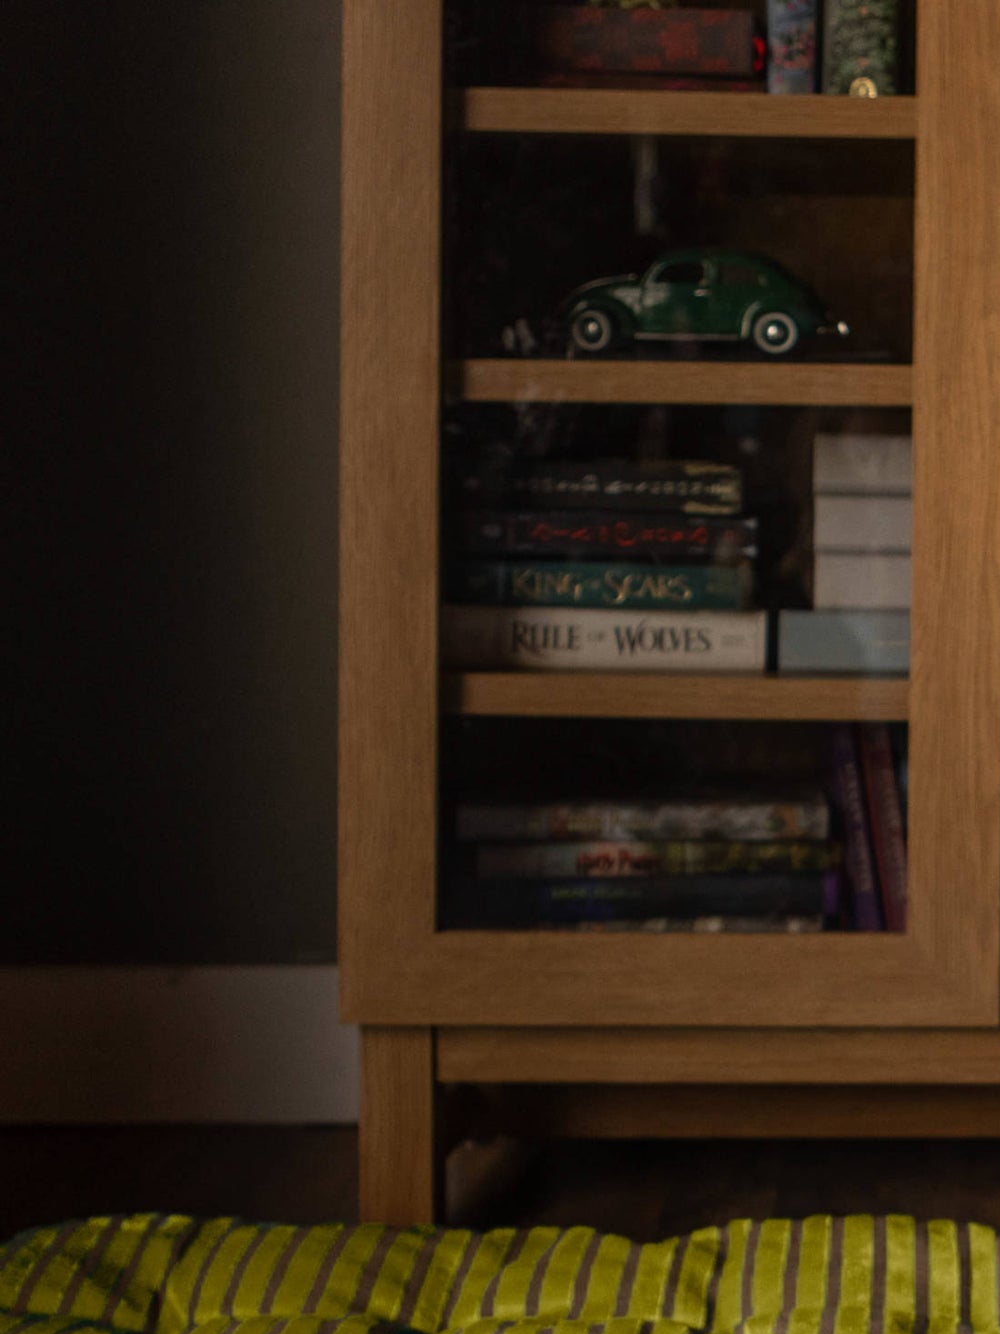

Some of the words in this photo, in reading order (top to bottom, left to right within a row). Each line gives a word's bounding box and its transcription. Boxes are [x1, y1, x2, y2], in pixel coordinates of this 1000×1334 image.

[512, 568, 582, 601] KING
[604, 569, 693, 604] SCARS
[511, 619, 580, 656] RULE
[614, 616, 712, 657] WOLVES
